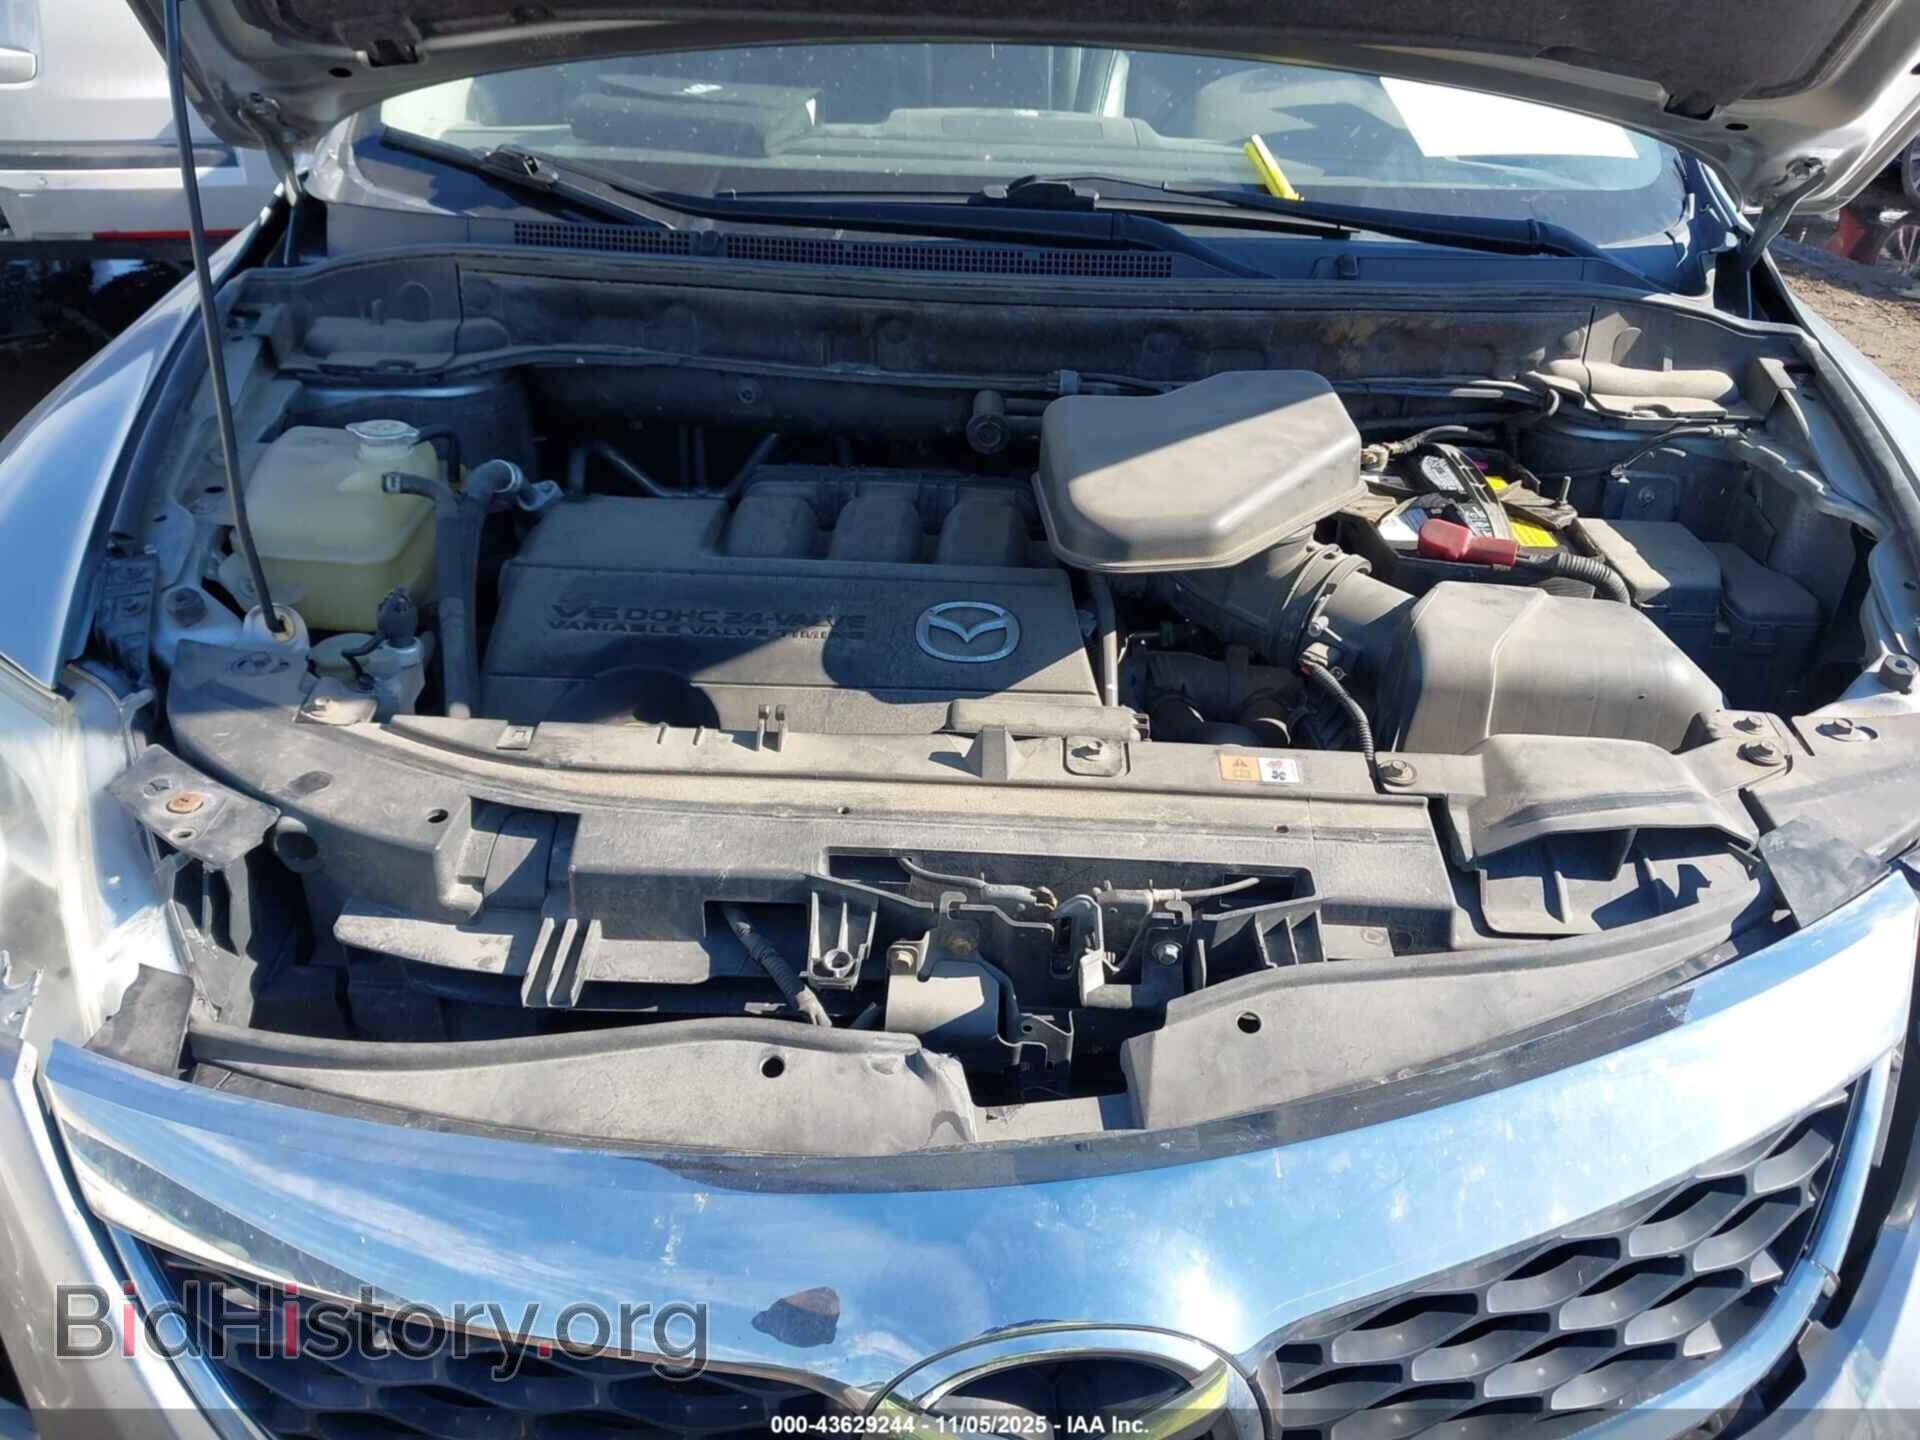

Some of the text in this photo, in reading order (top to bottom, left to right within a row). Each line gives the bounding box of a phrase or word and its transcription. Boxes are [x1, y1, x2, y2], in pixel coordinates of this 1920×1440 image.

[624, 607, 719, 623] DOHC
[549, 621, 681, 635] VARIABLE
[686, 624, 769, 637] VALVE
